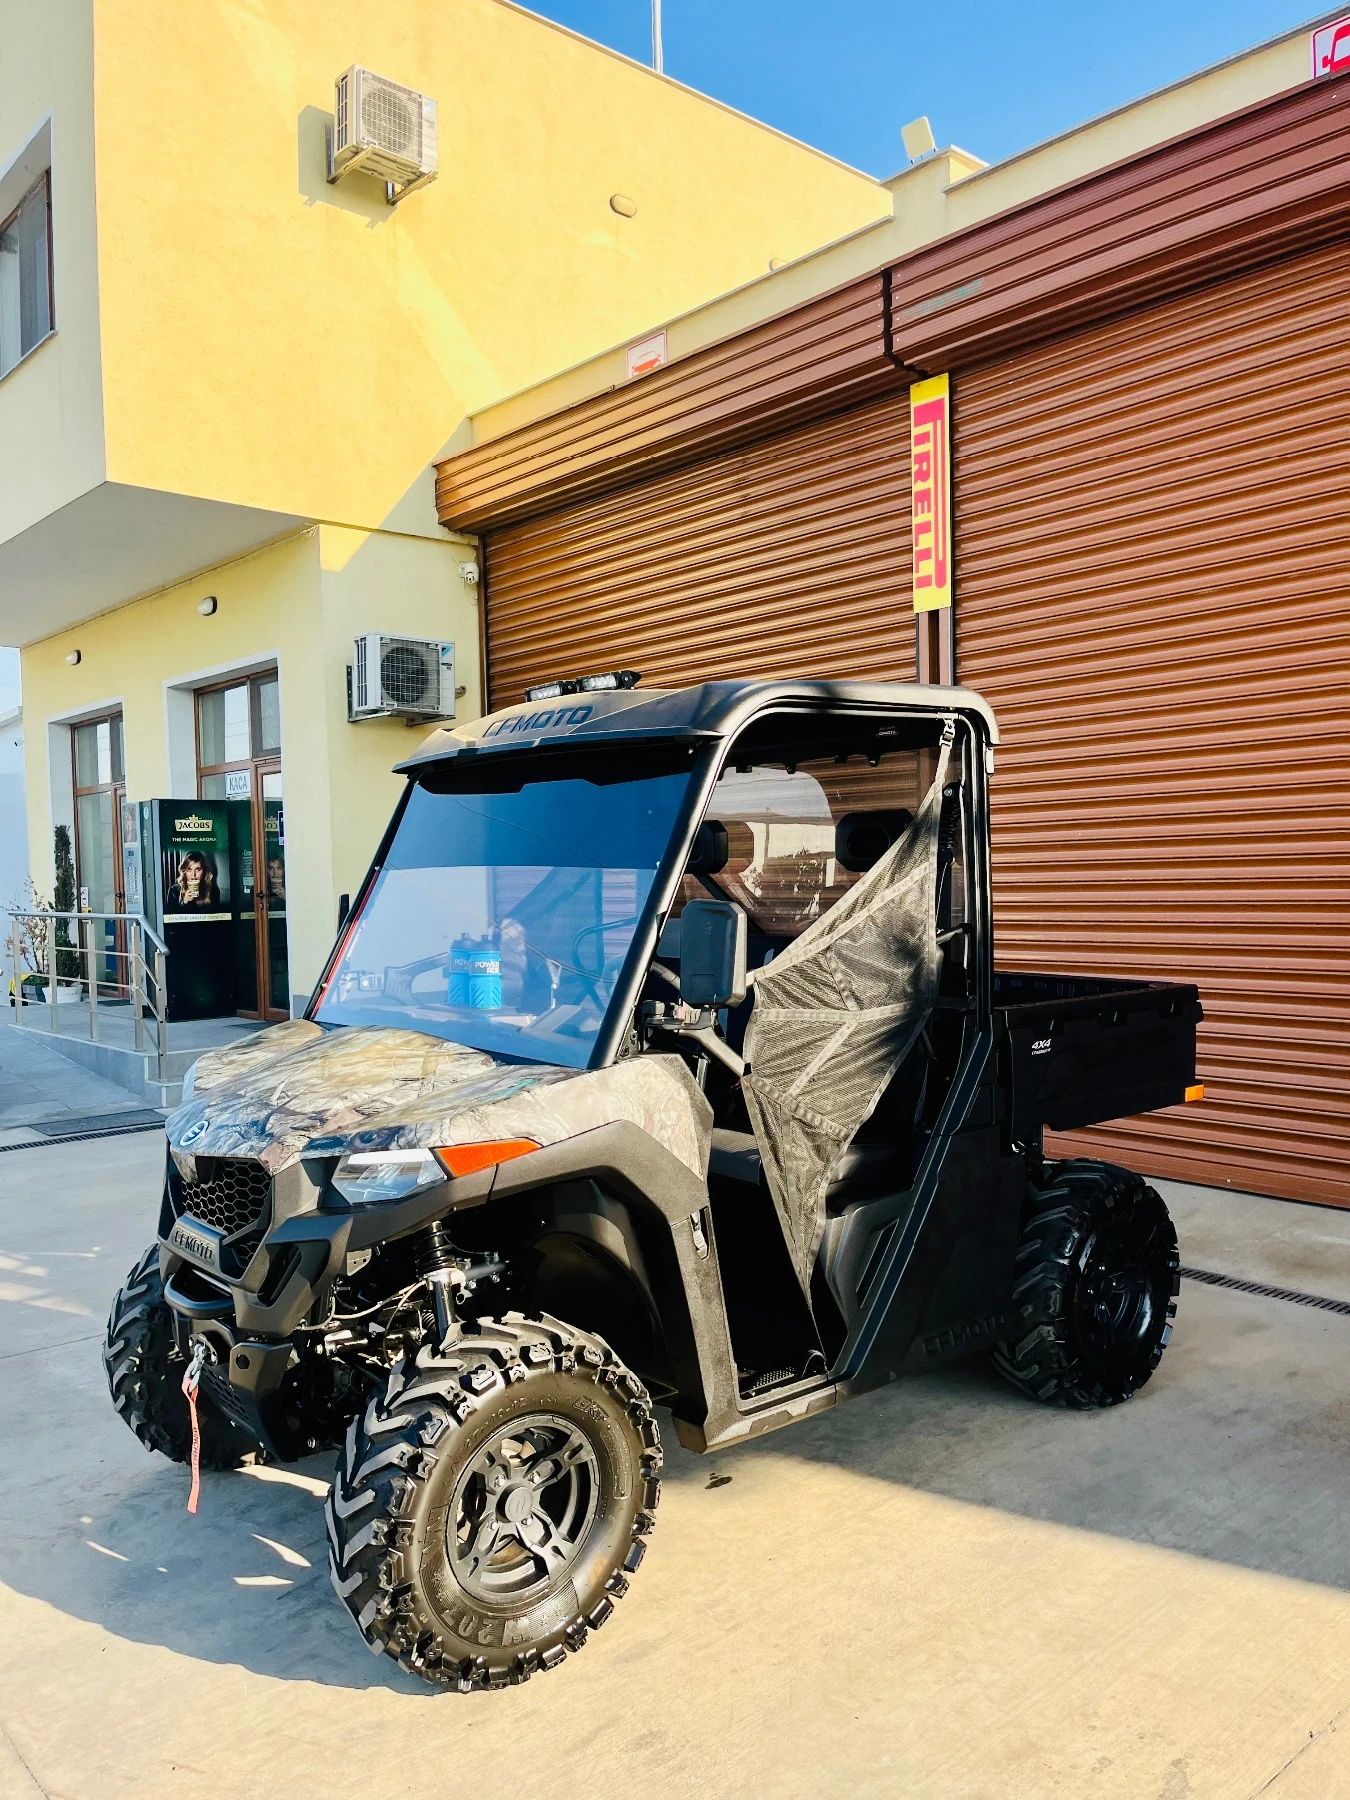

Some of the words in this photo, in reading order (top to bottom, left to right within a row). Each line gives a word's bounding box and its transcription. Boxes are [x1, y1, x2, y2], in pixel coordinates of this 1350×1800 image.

[912, 396, 947, 589] PIRELLI
[482, 705, 595, 738] CFMOTO
[178, 821, 210, 830] JACOBS
[173, 1229, 214, 1260] CFMOTO
